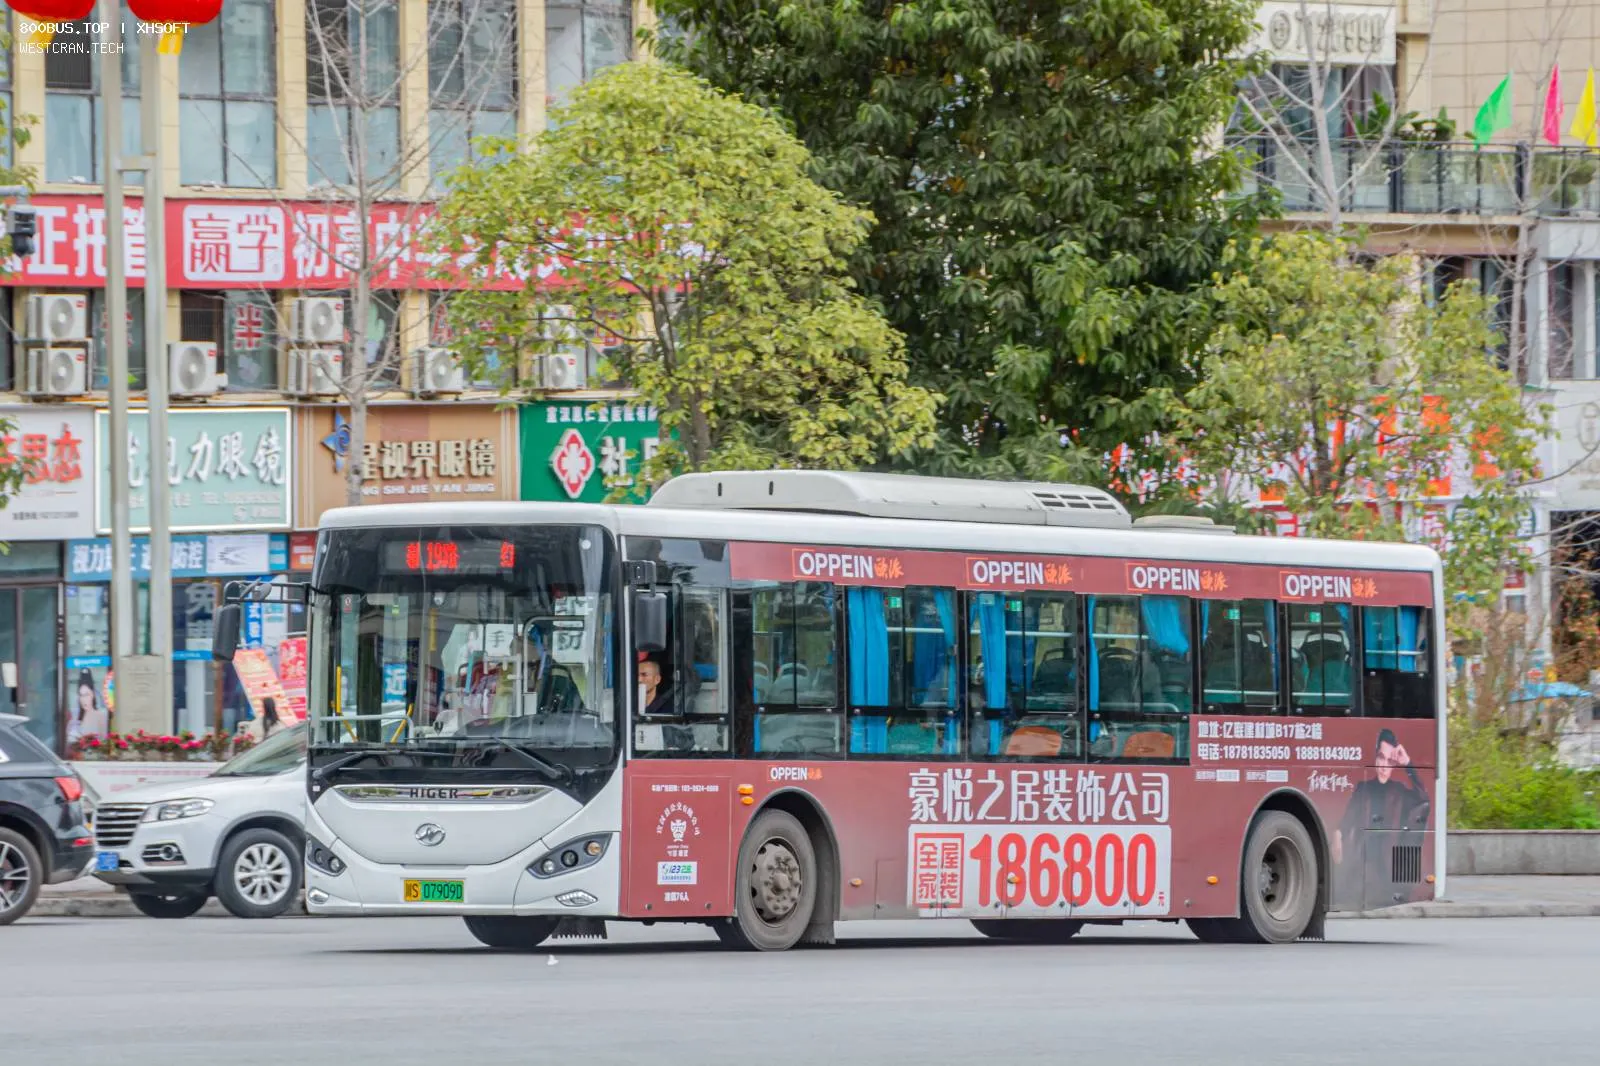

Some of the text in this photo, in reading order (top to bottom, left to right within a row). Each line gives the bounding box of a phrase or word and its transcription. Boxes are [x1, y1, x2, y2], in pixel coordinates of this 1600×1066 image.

[799, 552, 874, 579] OPPEIN
[973, 560, 1044, 585] OPPEIN
[1132, 566, 1200, 591] OPPEIN
[1285, 575, 1352, 598] OPPEIN
[770, 767, 808, 781] OPPEIN
[410, 787, 459, 799] HIGER
[908, 768, 1170, 823] 豪悦之居装饰公司
[970, 833, 1156, 907] 186800
